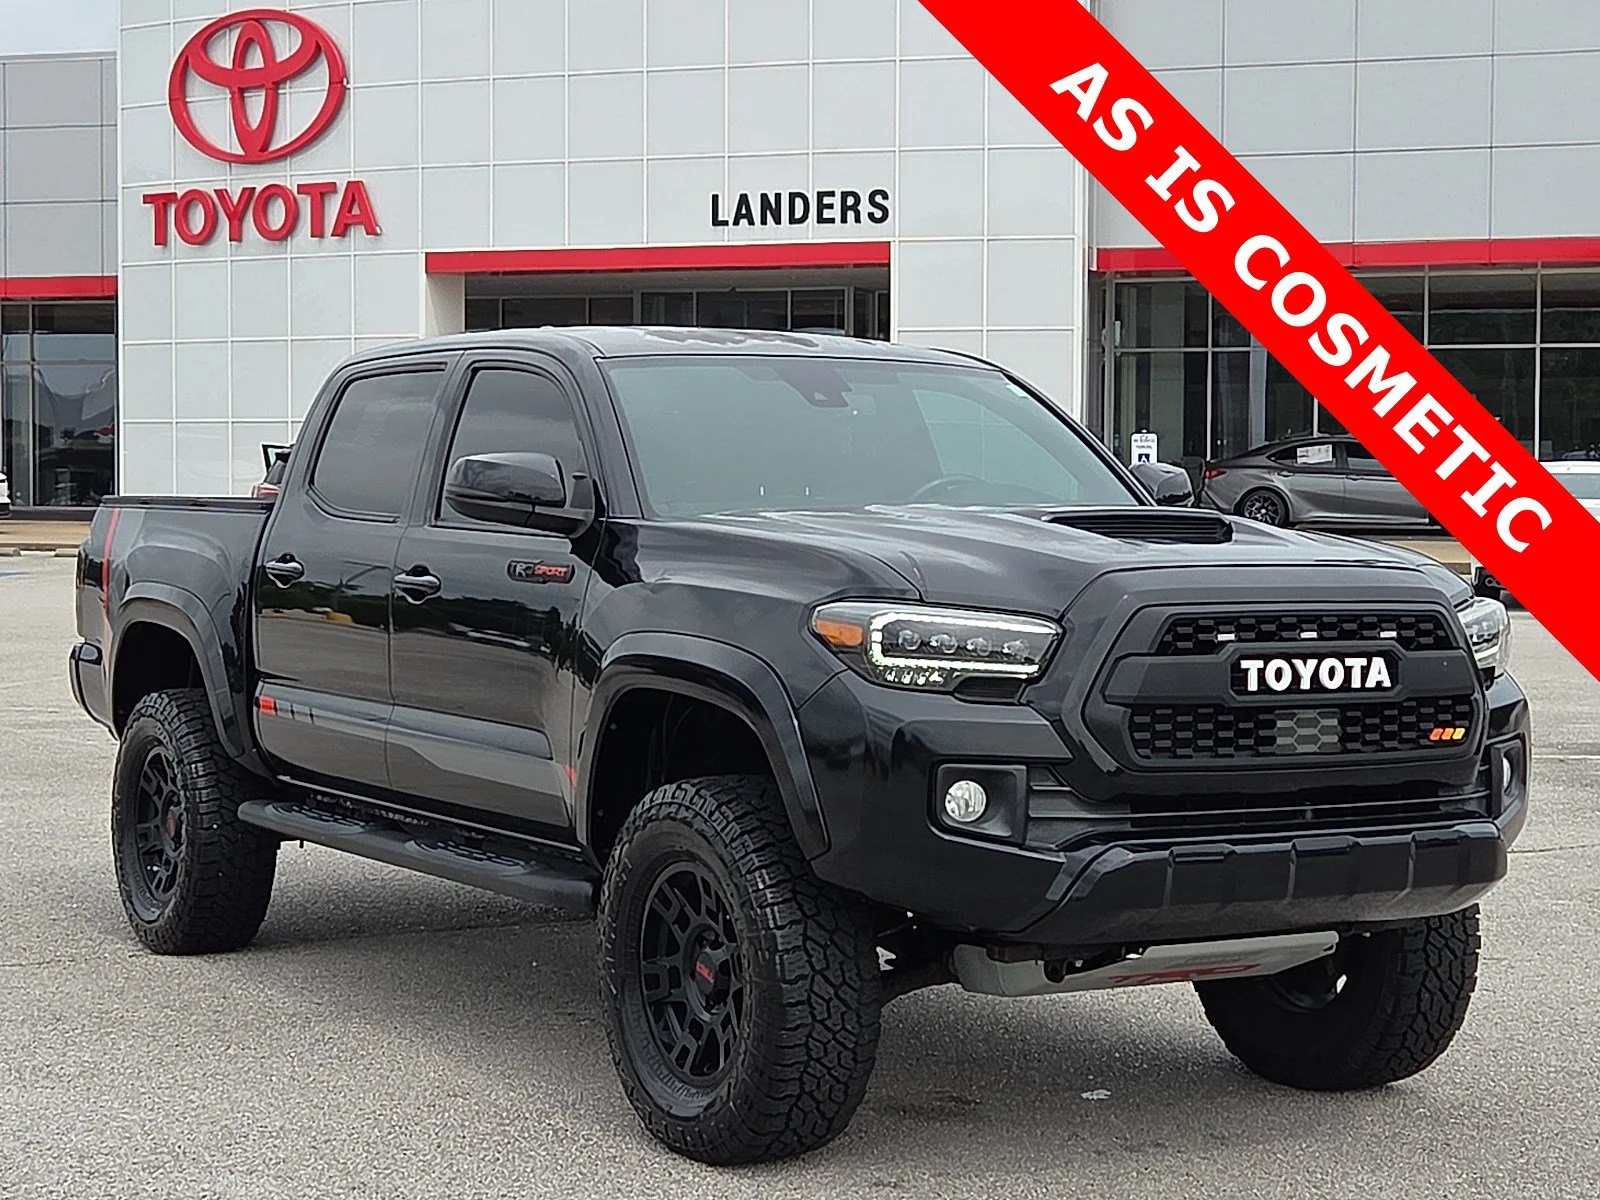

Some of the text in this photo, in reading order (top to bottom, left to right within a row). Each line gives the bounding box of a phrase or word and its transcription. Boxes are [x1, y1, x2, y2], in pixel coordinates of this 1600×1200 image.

[143, 180, 379, 246] TOYOTA
[711, 189, 890, 227] LANDERS
[1240, 656, 1392, 692] TOYOTA
